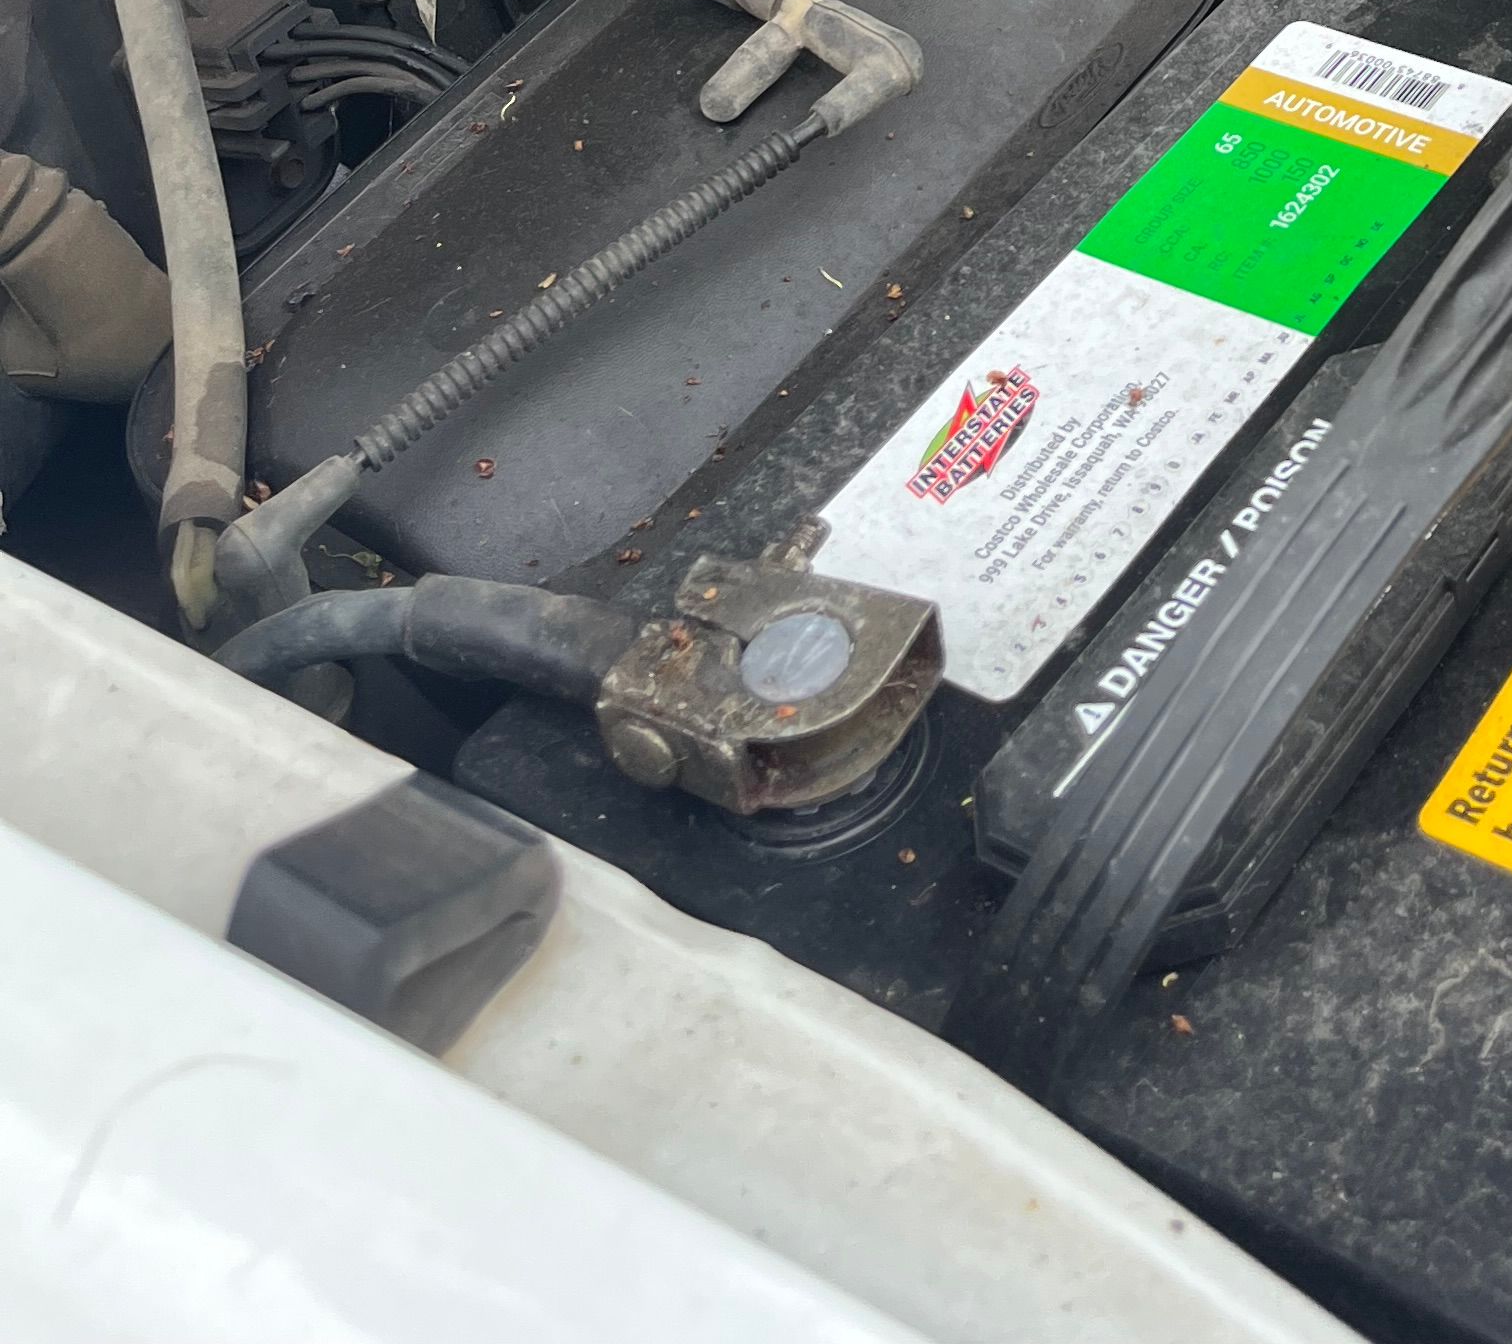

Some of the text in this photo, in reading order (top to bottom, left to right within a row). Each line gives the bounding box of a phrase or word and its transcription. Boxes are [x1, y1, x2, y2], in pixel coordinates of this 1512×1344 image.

[1230, 140, 1267, 170] 850
[1246, 148, 1291, 184] 1000
[1263, 89, 1433, 154] AUTOMOTIVE
[1280, 156, 1315, 185] 150
[1133, 203, 1174, 245] GROUP
[1213, 131, 1242, 154] 65
[1268, 163, 1340, 229] 1624302
[911, 369, 1027, 494] INTERSTATE
[935, 386, 1038, 497] BATTERIES
[973, 380, 1143, 560] Costco Wholesale Corporation,
[999, 415, 1082, 501] Distributed by
[978, 556, 1008, 585] 999
[1002, 524, 1038, 559] Lake
[1030, 491, 1072, 527] Drive,
[1062, 431, 1123, 490] Issaquah,
[1114, 407, 1140, 428] WA
[1031, 409, 1176, 570] For warranty, return to Costco.
[1098, 418, 1333, 698] DANGER / POISON
